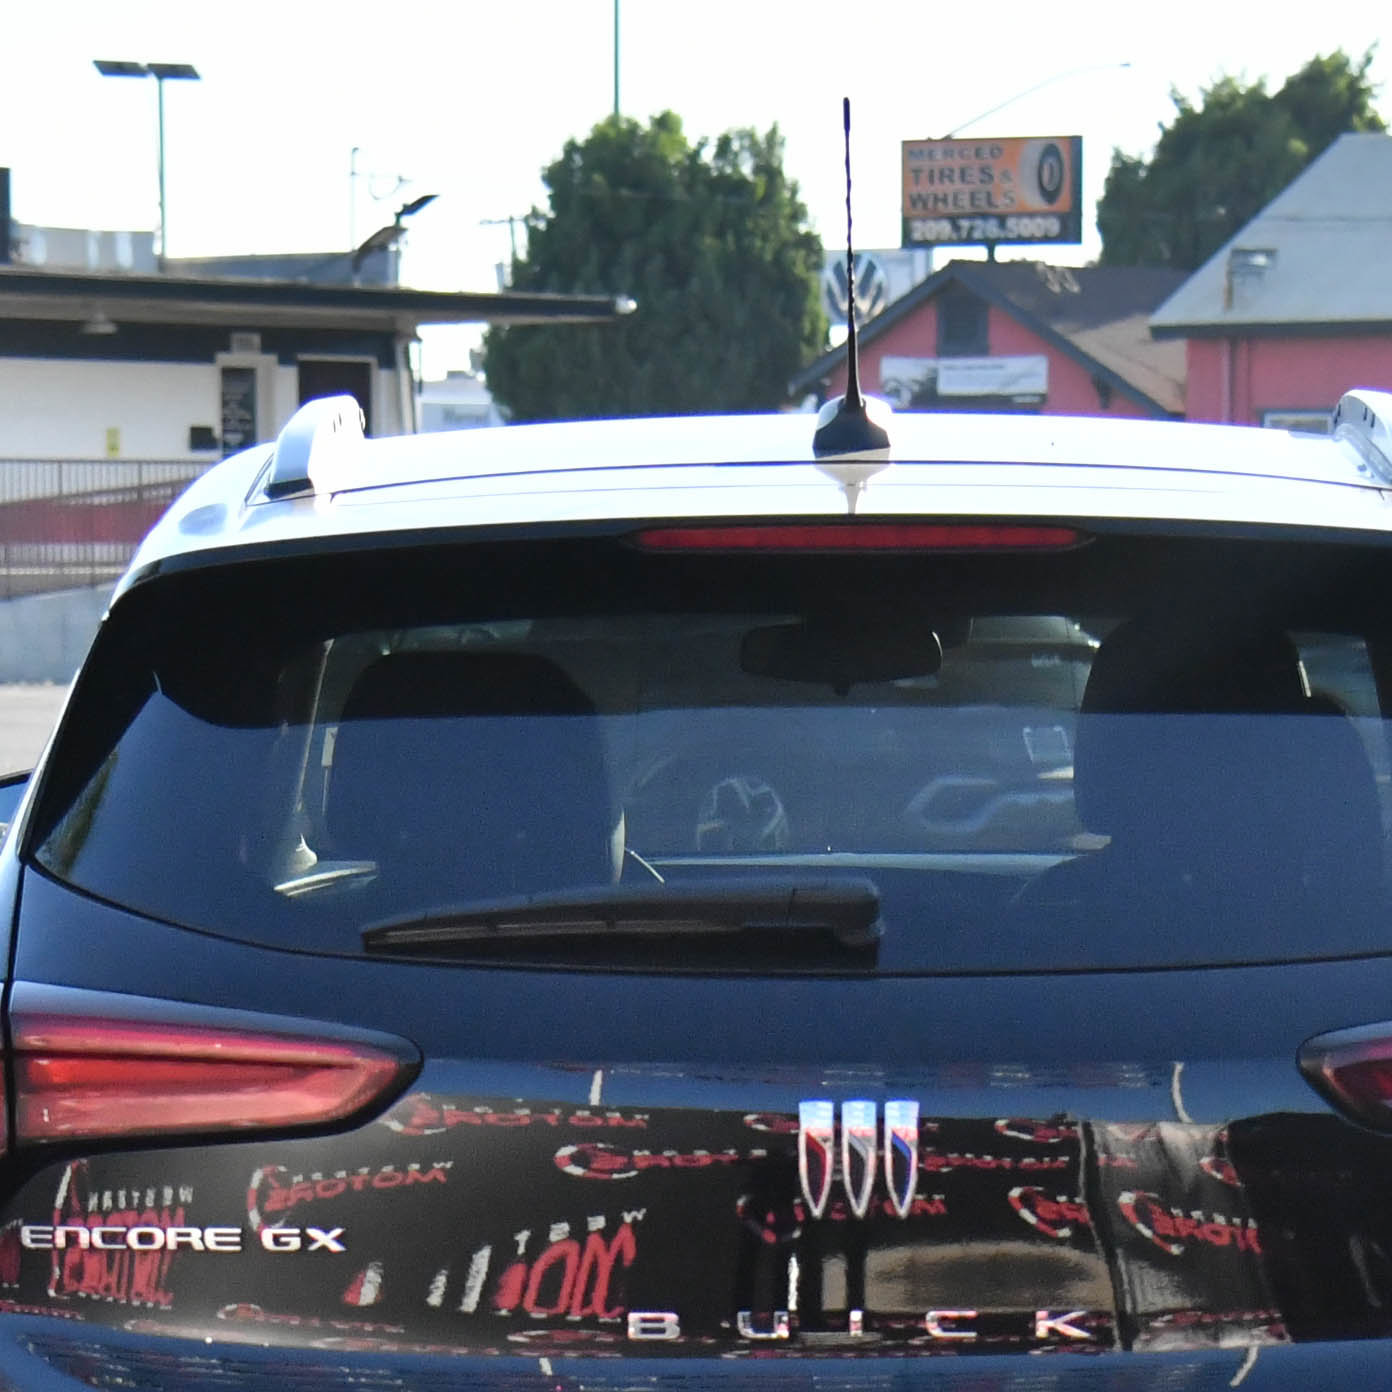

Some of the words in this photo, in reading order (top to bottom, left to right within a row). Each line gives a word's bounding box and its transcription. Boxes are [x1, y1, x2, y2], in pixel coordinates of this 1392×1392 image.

[911, 166, 995, 185] TIRES
[910, 191, 1017, 210] WHEELS
[20, 1226, 243, 1250] ENCORE
[260, 1227, 347, 1251] GX
[626, 1309, 1092, 1340] BUICK
